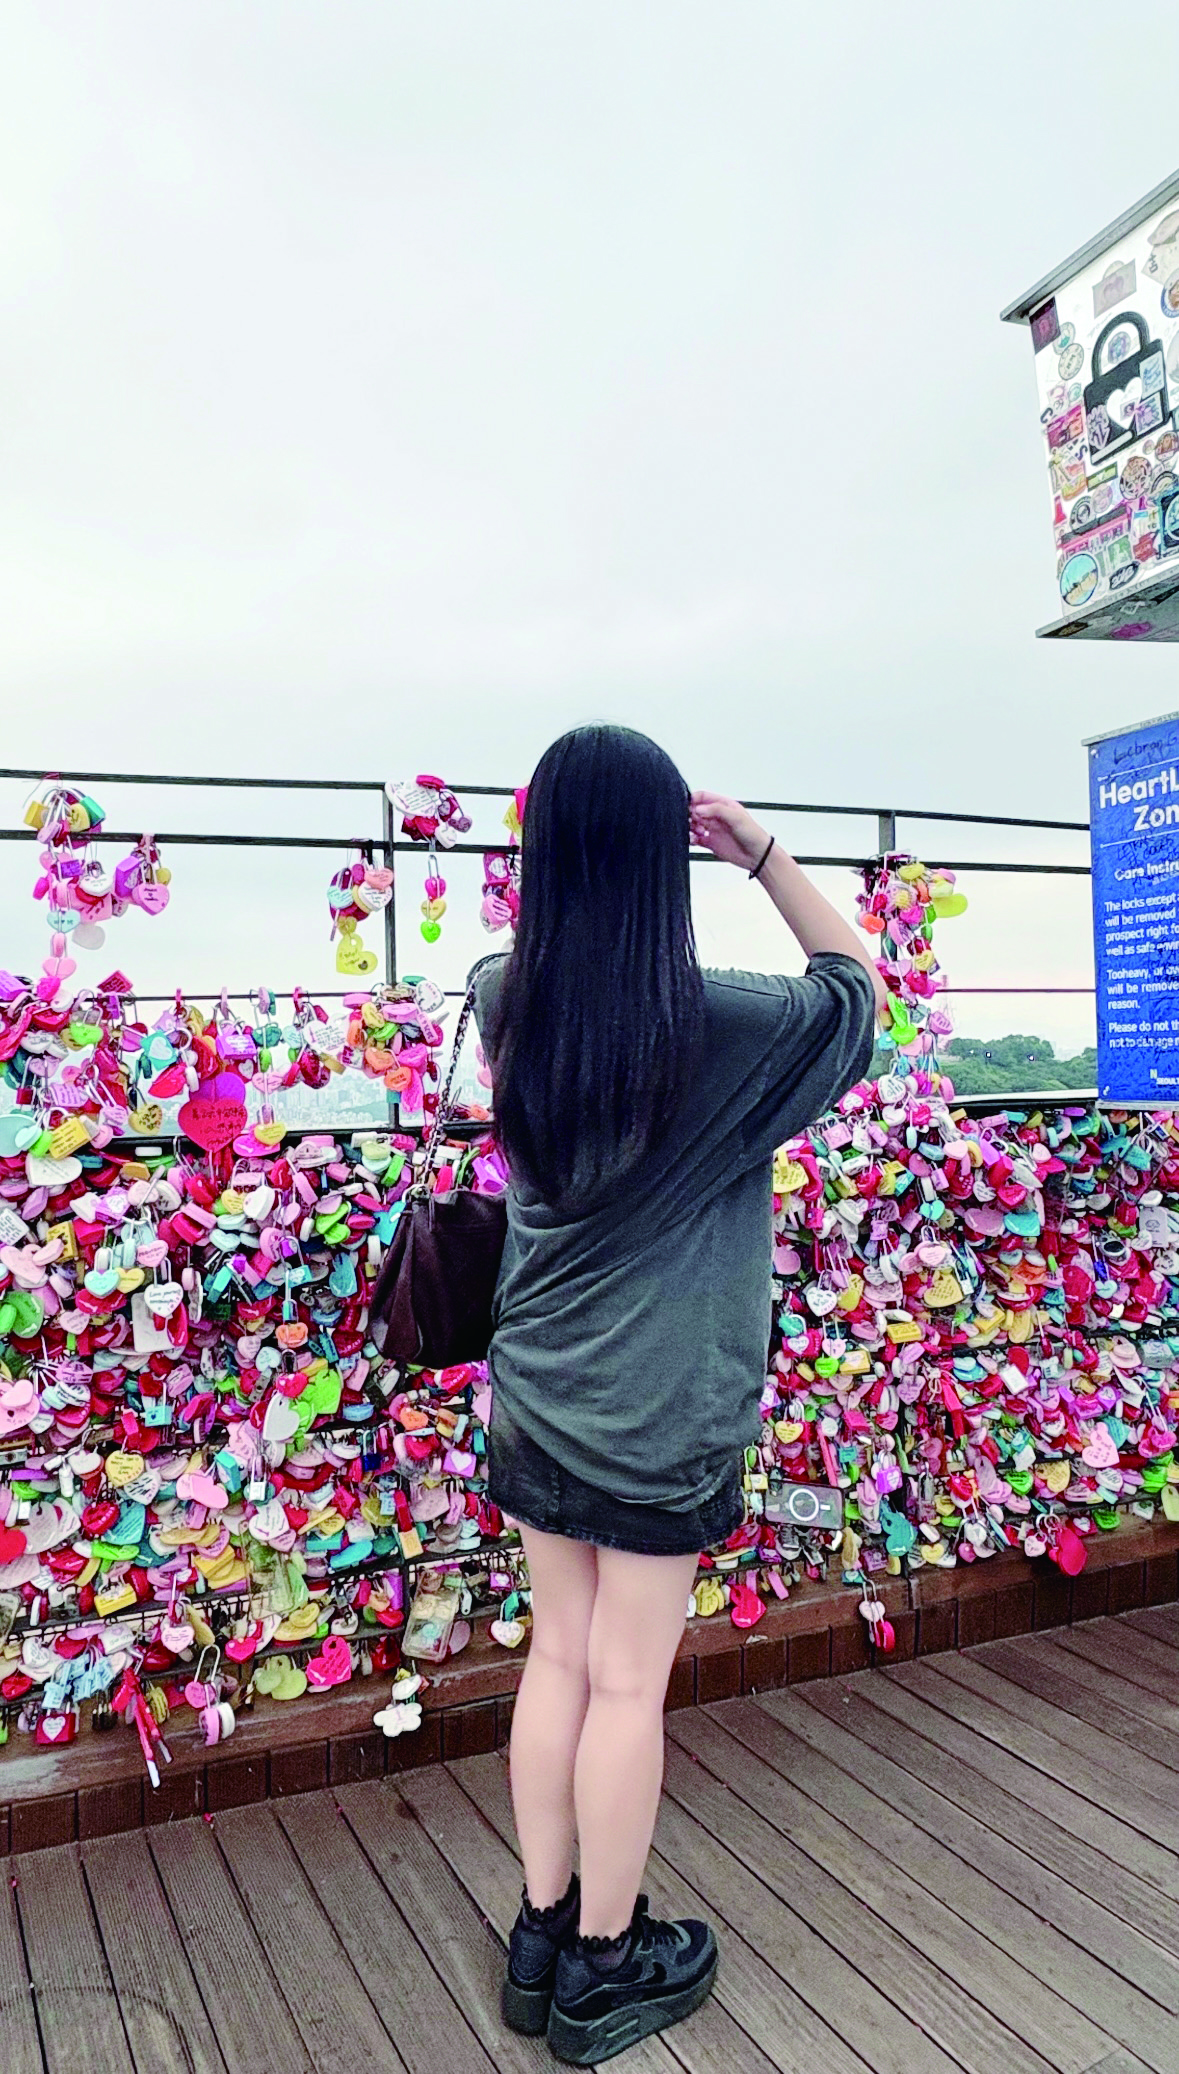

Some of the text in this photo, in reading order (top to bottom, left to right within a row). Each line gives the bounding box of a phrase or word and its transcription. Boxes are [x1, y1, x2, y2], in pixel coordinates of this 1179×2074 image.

[1099, 767, 1179, 809] HeartL
[1133, 804, 1179, 832] Zon
[1114, 867, 1145, 882] Care
[1104, 892, 1176, 912] The locks except
[1105, 907, 1175, 927] will be removed
[1105, 928, 1144, 945] prospect
[1146, 924, 1169, 939] right
[1105, 944, 1123, 956] well
[1124, 945, 1135, 955] as
[1136, 941, 1155, 954] safe
[1153, 966, 1164, 976] or
[1107, 981, 1179, 995] will be remove
[1108, 999, 1141, 1010] reason.
[1109, 1021, 1138, 1033] Please
[1139, 1020, 1152, 1032] do
[1153, 1020, 1170, 1032] not
[1109, 1037, 1126, 1048] not
[1125, 1037, 1136, 1048] to
[1136, 1035, 1173, 1050] damage
